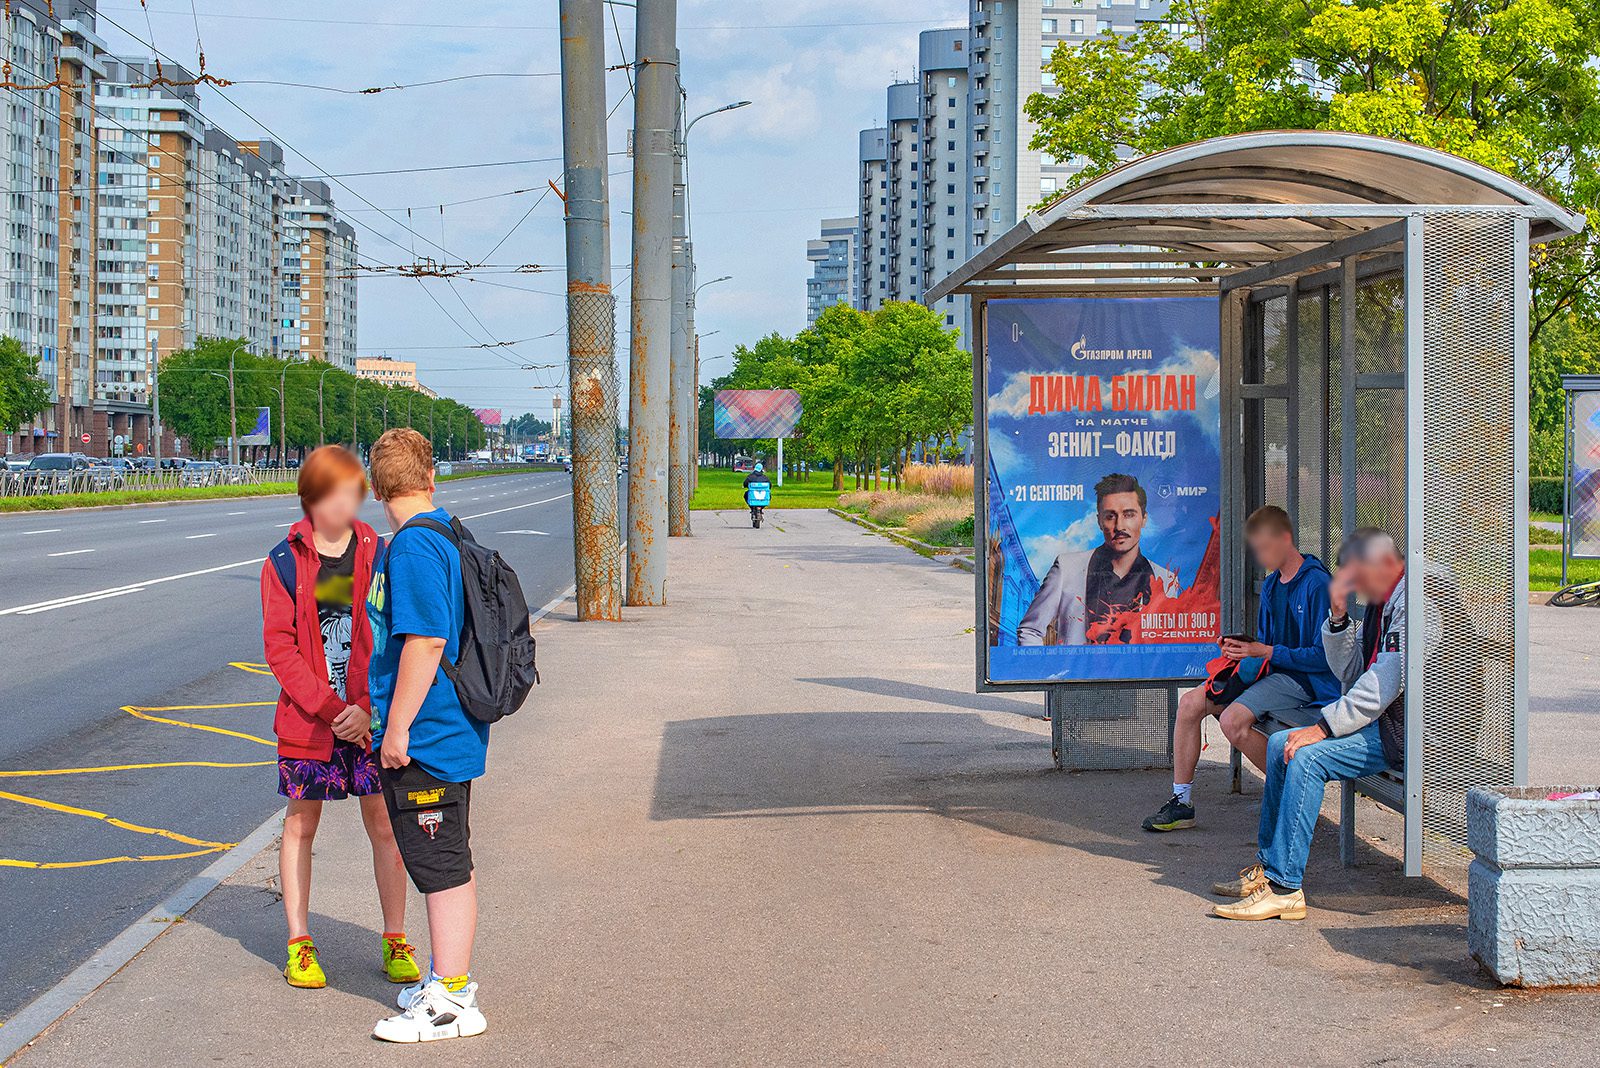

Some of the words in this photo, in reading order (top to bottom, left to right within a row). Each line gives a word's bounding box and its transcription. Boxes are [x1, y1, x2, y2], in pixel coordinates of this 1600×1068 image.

[1012, 322, 1024, 343] 0+
[1087, 349, 1124, 360] ГАЗПРОМ
[1127, 349, 1153, 360] АРЕНА
[1027, 375, 1103, 416] ДИМА
[1111, 374, 1196, 411] БИЛАН
[1075, 418, 1095, 426] НА
[1101, 418, 1148, 426] МАТЧЕ
[1015, 485, 1027, 502] 21
[1029, 484, 1084, 502] СЕНТЯБРЯ
[1176, 486, 1208, 496] МИР
[1141, 613, 1176, 629] БИЛЕТЫ
[1178, 613, 1189, 629] ОТ
[1191, 612, 1207, 629] 300
